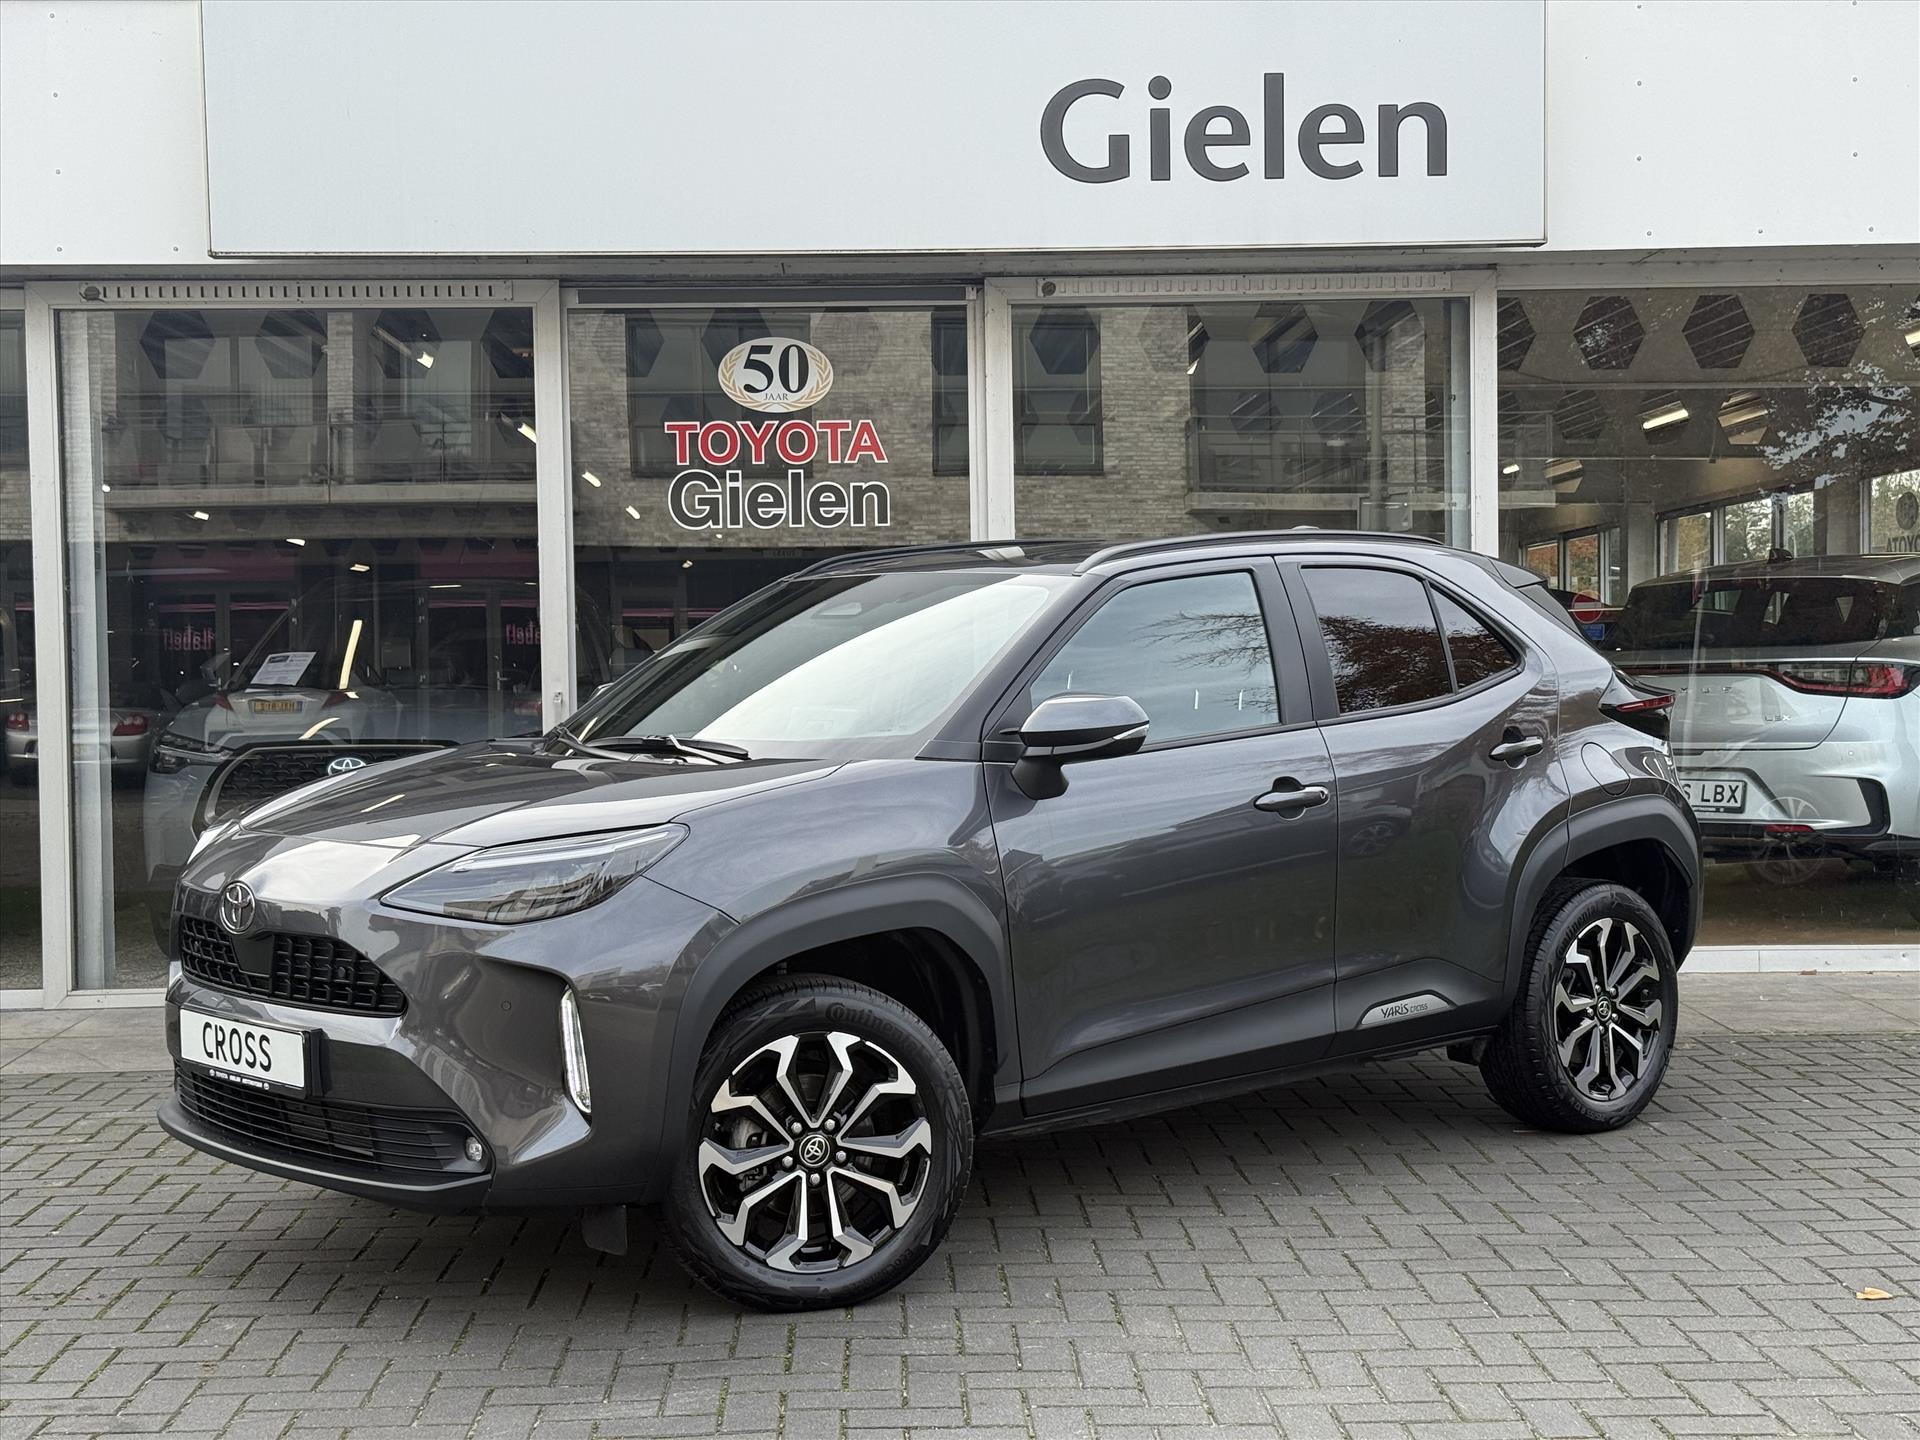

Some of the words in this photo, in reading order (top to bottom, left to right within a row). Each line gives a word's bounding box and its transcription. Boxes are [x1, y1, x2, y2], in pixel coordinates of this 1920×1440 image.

[1040, 72, 1448, 184] Gielen
[742, 344, 810, 394] 50
[764, 393, 789, 401] JAAR
[665, 420, 888, 465] TOYOTA
[668, 470, 890, 530] Gielen
[1700, 784, 1739, 804] LBX
[202, 1021, 272, 1073] CROSS
